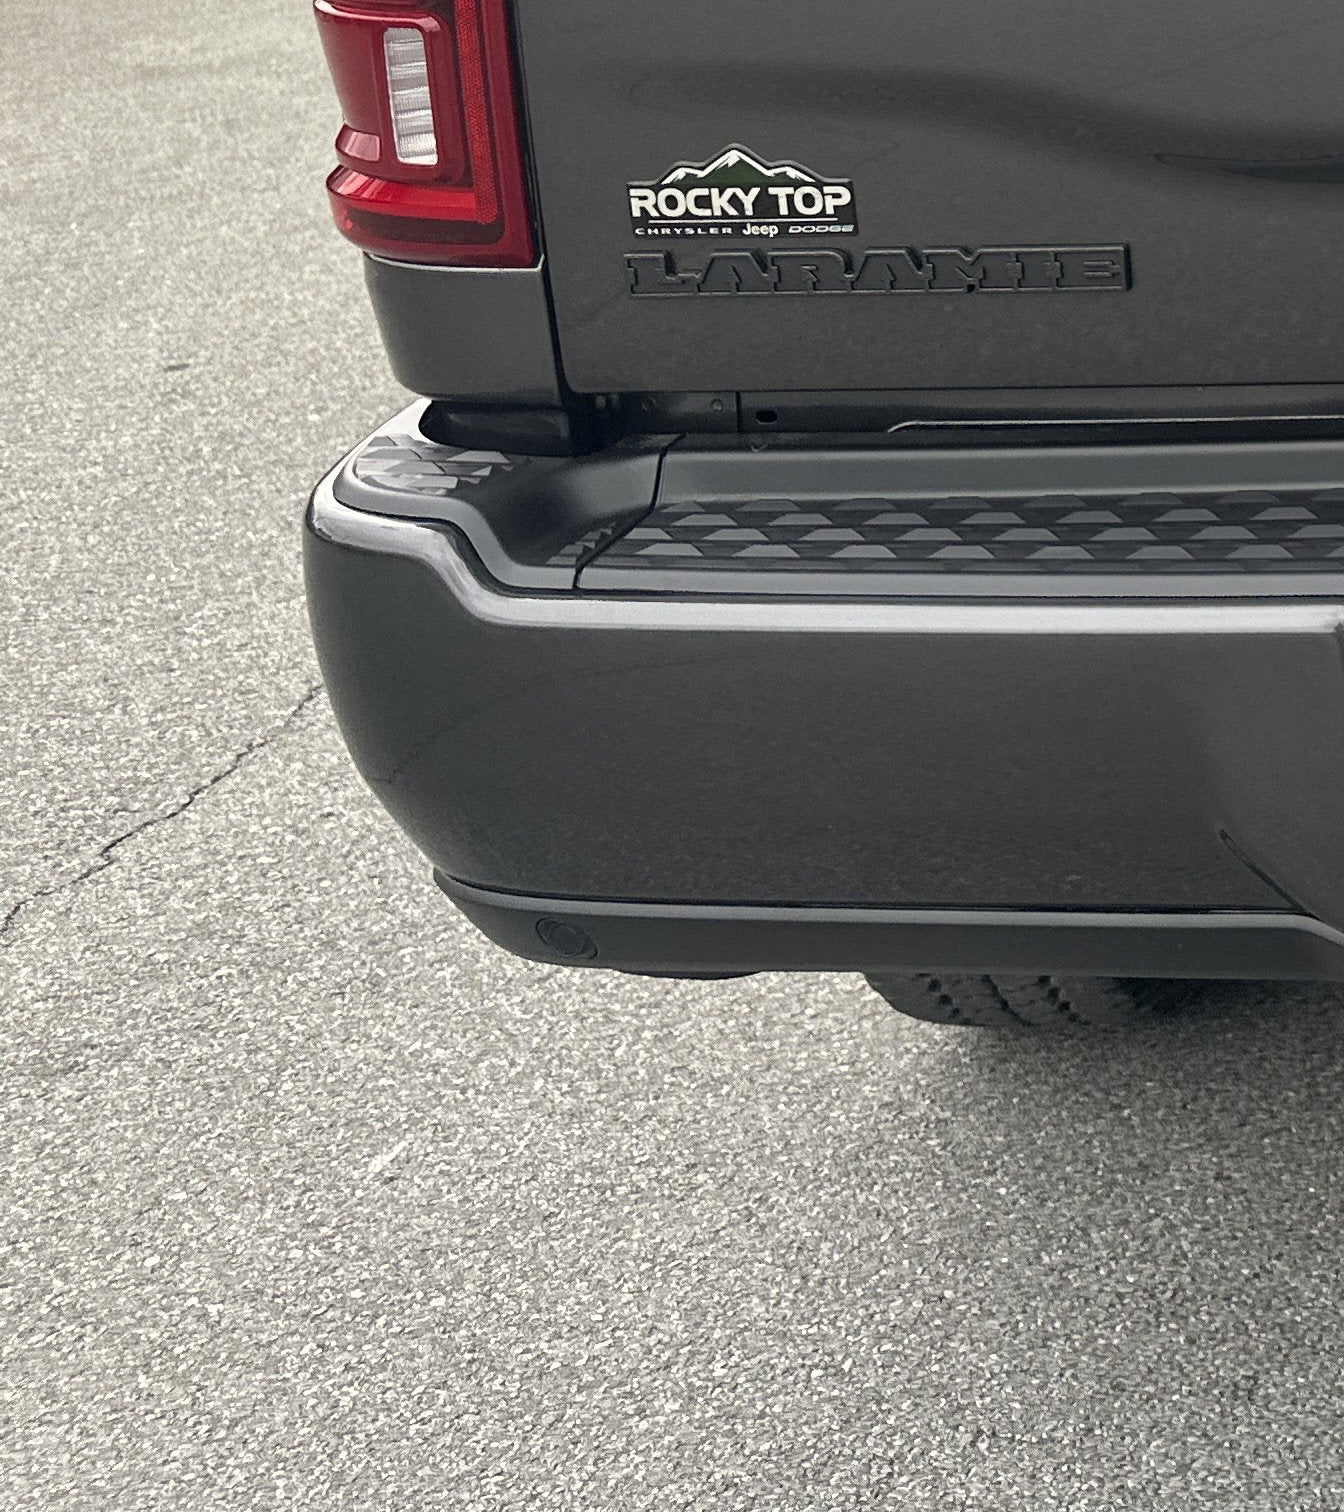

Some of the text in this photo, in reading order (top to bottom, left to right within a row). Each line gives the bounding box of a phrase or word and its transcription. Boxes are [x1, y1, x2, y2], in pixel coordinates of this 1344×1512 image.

[630, 186, 852, 217] ROCKY TOP
[634, 223, 855, 238] CHRYSLER Jeep DODGE
[624, 244, 1132, 296] LARAMIE
